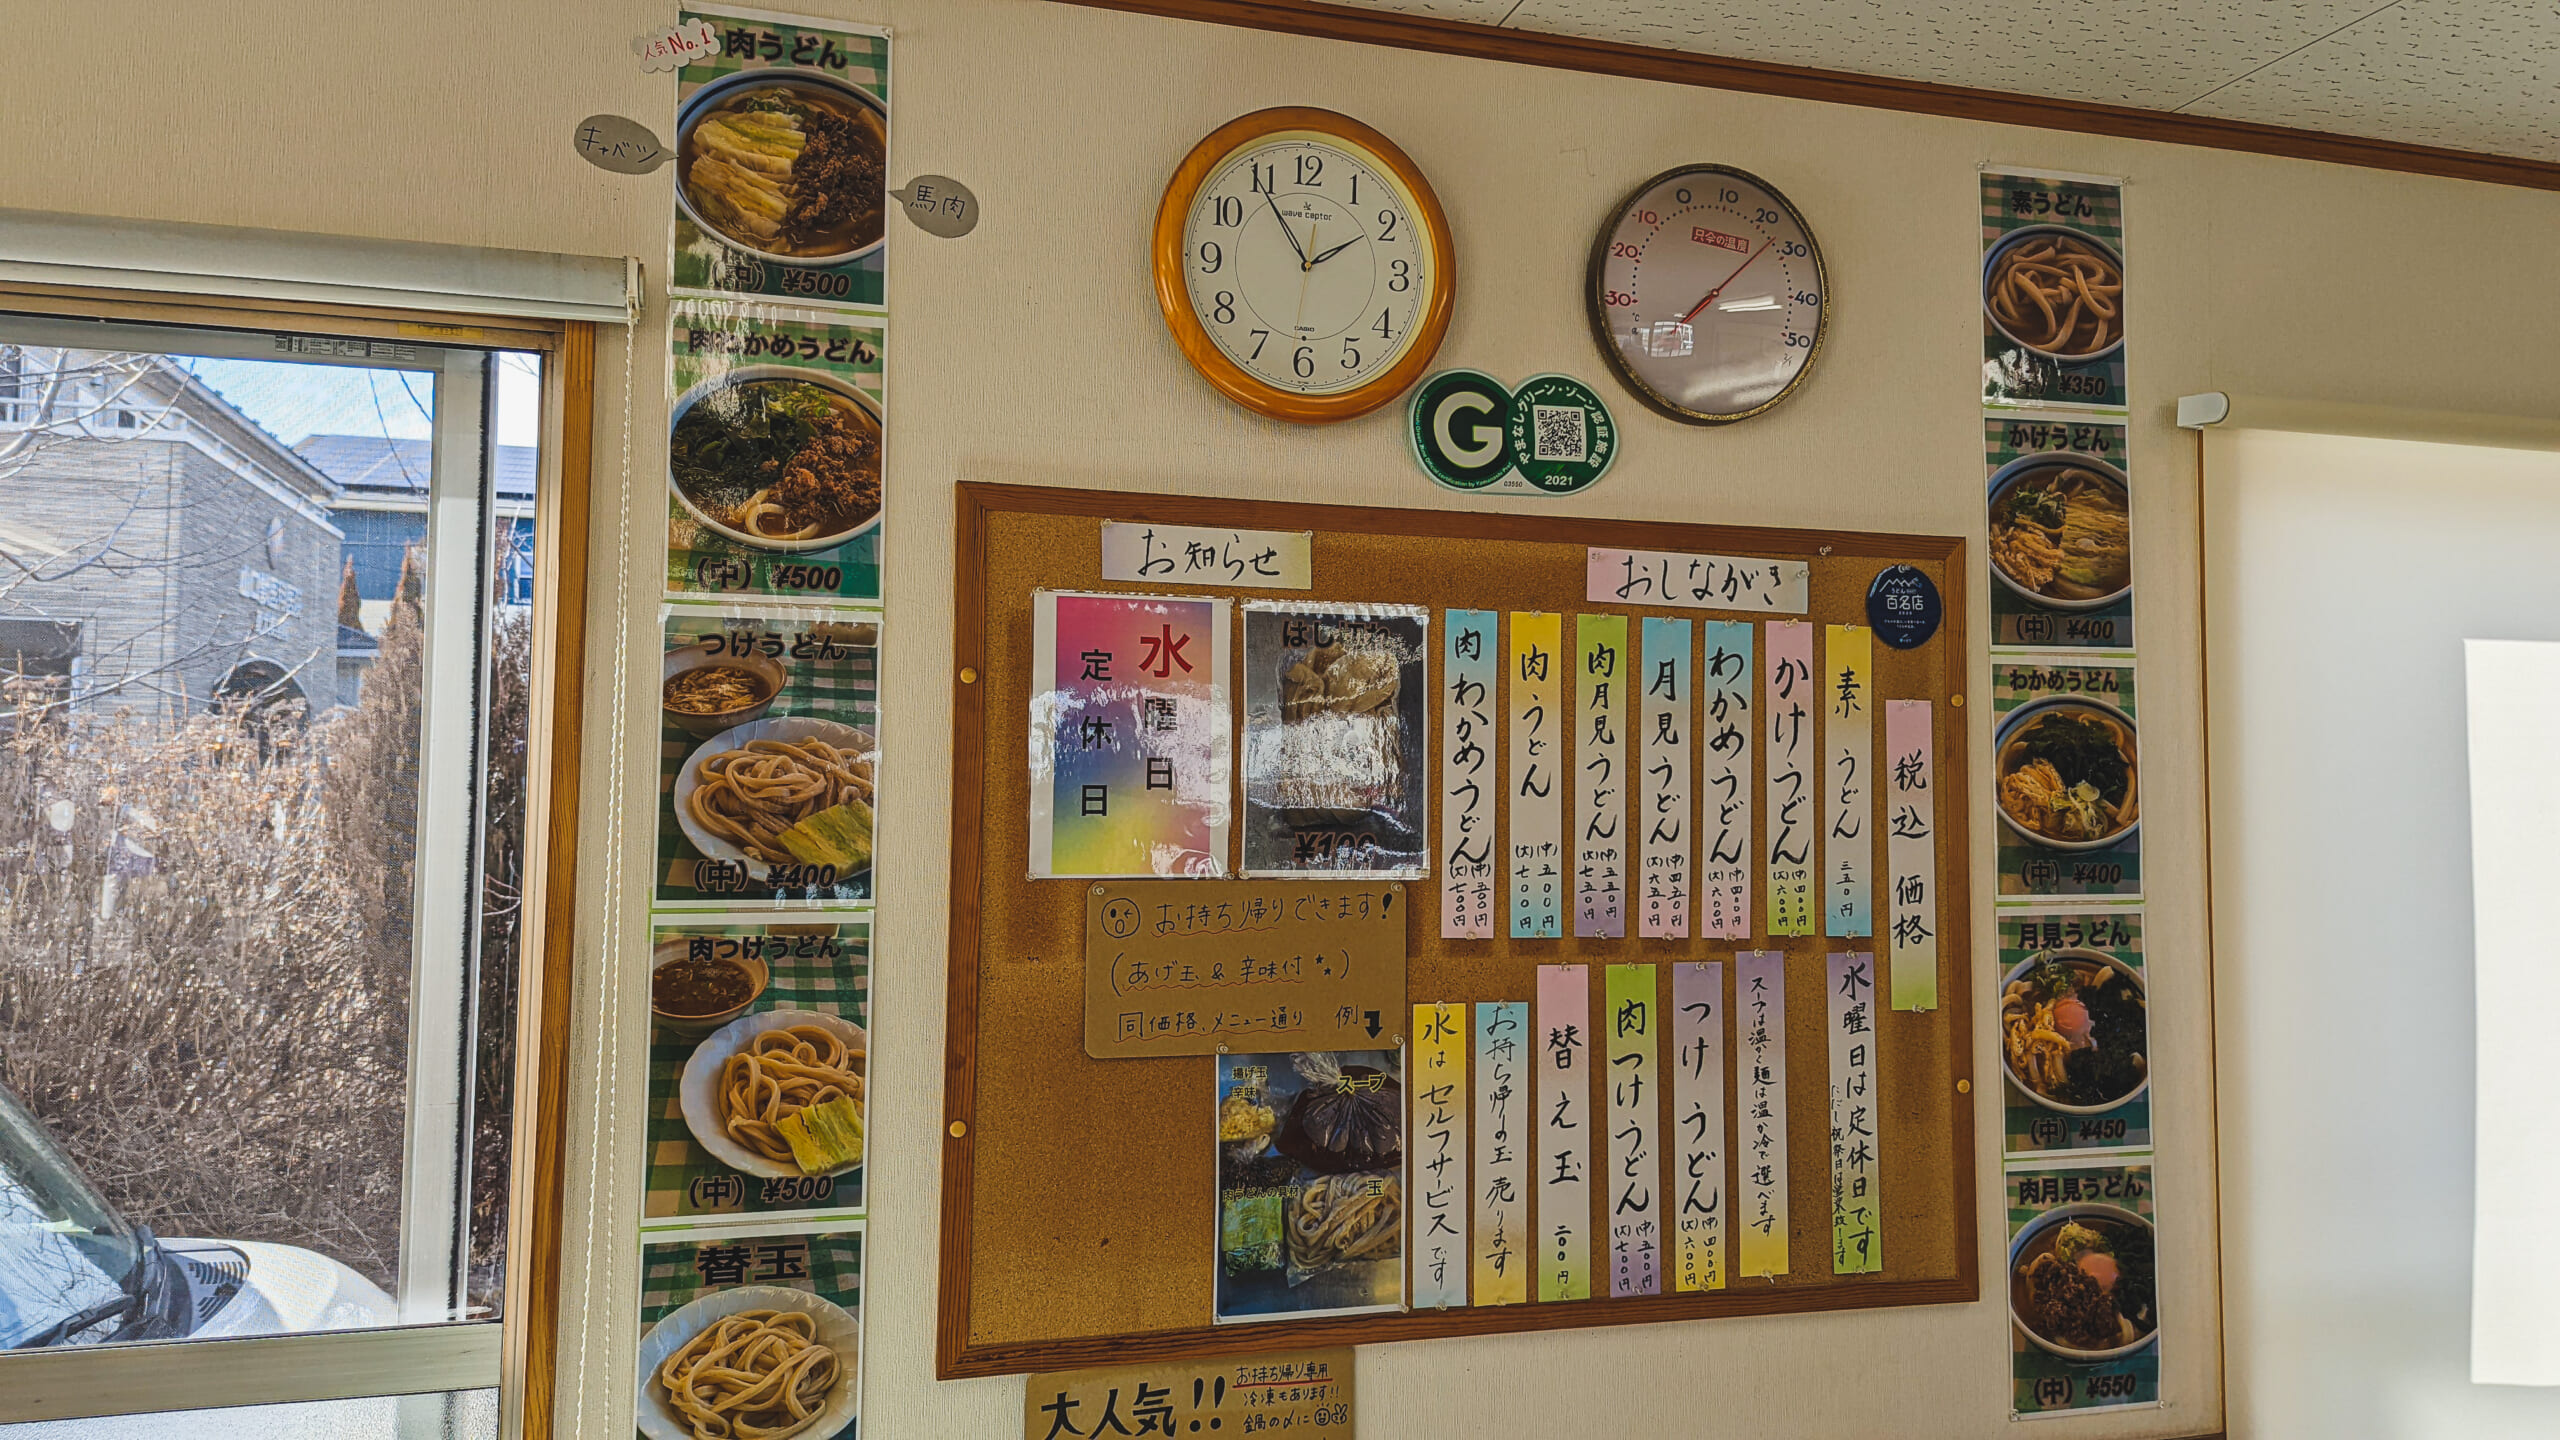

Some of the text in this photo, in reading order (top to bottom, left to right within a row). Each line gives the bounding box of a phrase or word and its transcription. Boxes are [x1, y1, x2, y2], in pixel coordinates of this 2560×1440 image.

[644, 28, 711, 61] 人気 No.1
[725, 28, 848, 69] 肉うどん
[582, 127, 660, 164] キャベツ
[1250, 162, 1276, 195] 11
[1293, 154, 1323, 187] 12
[910, 185, 965, 219] 馬肉
[1349, 173, 1360, 205] 1
[1676, 188, 1692, 204] 0
[1719, 188, 1739, 204] 10
[2011, 190, 2093, 218] 素うどん
[1212, 195, 1243, 228] 10
[1282, 210, 1302, 218] wave
[1377, 209, 1397, 242] 2
[1632, 210, 1658, 225] -10
[1755, 208, 1778, 224] 20
[1611, 242, 1639, 259] -20
[1693, 227, 1748, 253] 只今の温度
[1781, 241, 1807, 258] 30
[1200, 241, 1222, 274] 9
[782, 268, 851, 297] ¥500
[1388, 259, 1410, 292] 3
[1213, 291, 1235, 324] 8
[1795, 290, 1819, 306] 40
[1371, 306, 1394, 339] 4
[1249, 328, 1270, 360] 7
[1340, 337, 1361, 369] 5
[1784, 333, 1811, 349] 50
[1293, 346, 1314, 378] 6
[2058, 375, 2106, 396] ¥350
[1433, 391, 1503, 468] G
[2009, 425, 2110, 451] かけうどん
[1544, 476, 1573, 486] 2021
[1138, 528, 1280, 581] お知らせ
[697, 557, 841, 591] (中) ¥500
[1616, 555, 1783, 606] おしながき
[1886, 594, 1924, 610] 百名店
[2016, 614, 2114, 641] (中) ¥400
[697, 631, 848, 661] つけうどん
[2009, 669, 2120, 692] わかめうどん
[1138, 624, 1194, 791] 水曜日
[1520, 643, 1551, 798] 肉うどん
[1080, 649, 1113, 816] 定休日
[1449, 627, 1492, 865] 肉わかめうどん
[1586, 643, 1618, 840] 肉月見うどん
[1648, 658, 1681, 844] 月見うどん
[1708, 646, 1748, 864] わかめうどん
[1771, 657, 1810, 865] かけうどん
[1832, 665, 1861, 839] 素うどん
[1891, 748, 1934, 949] 税込価格
[693, 859, 836, 892] (中) ¥400
[2021, 860, 2122, 887] (中) ¥400
[688, 935, 842, 962] 肉つけうどん
[2018, 920, 2131, 949] 月見うどん
[1335, 1004, 1359, 1029] 例
[1336, 1073, 1387, 1095] スープ
[1547, 1024, 1583, 1185] 替え玉
[1612, 999, 1650, 1215] 肉つけうどん
[1681, 1003, 1718, 1214] つけうどん
[1839, 962, 1875, 1265] 水曜日は定休日です
[1485, 1006, 1518, 1278] お持ち帰りの玉売ります
[2031, 1116, 2126, 1145] (中) ¥450
[1420, 1012, 1459, 1290] 水はセルフサービスです
[688, 1175, 833, 1208] (中) ¥500
[1366, 1179, 1384, 1197] 玉
[2018, 1174, 2144, 1205] 肉月見うどん
[697, 1244, 808, 1287] 替玉
[1235, 1362, 1329, 1386] お持ち帰り専用
[2034, 1374, 2136, 1406] (中) ¥550
